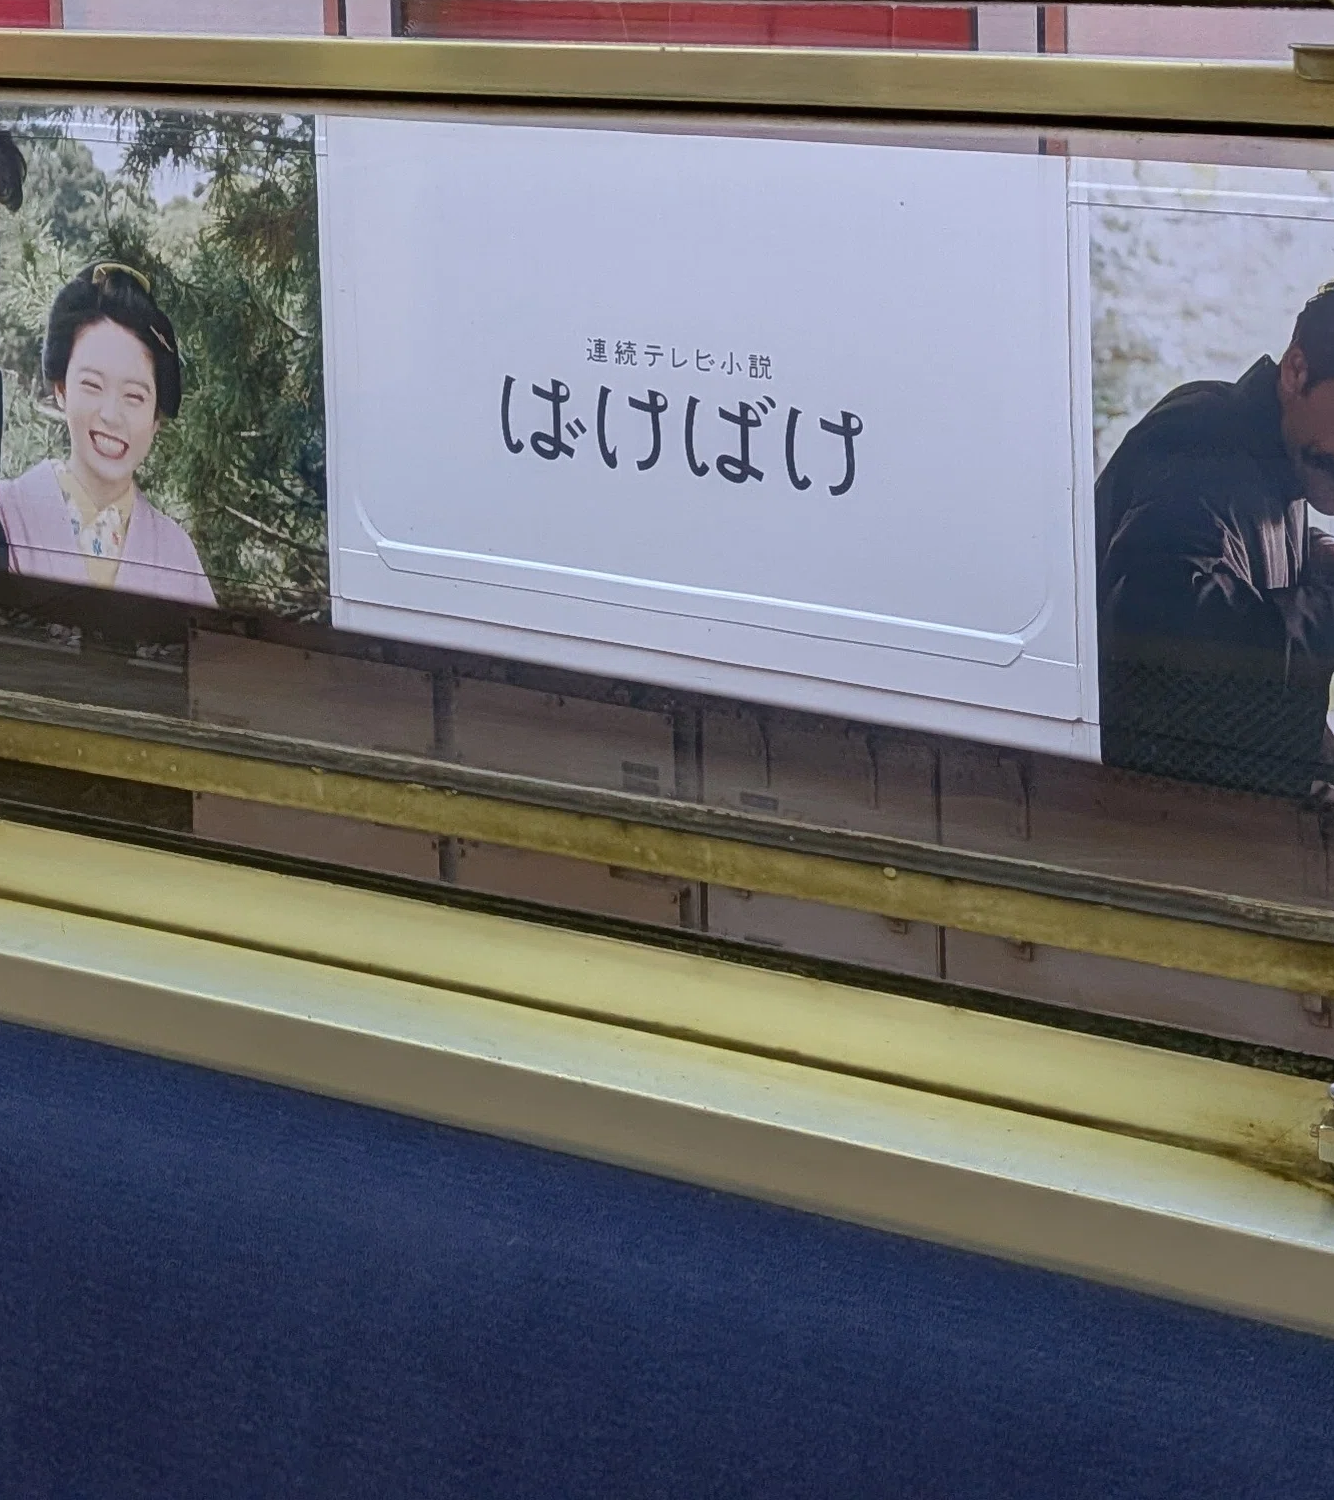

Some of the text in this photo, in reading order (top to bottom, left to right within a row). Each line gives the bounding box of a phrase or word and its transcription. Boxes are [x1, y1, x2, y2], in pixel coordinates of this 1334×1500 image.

[585, 337, 773, 381] 連続テレビ小説
[501, 374, 864, 497] ばけばけ
